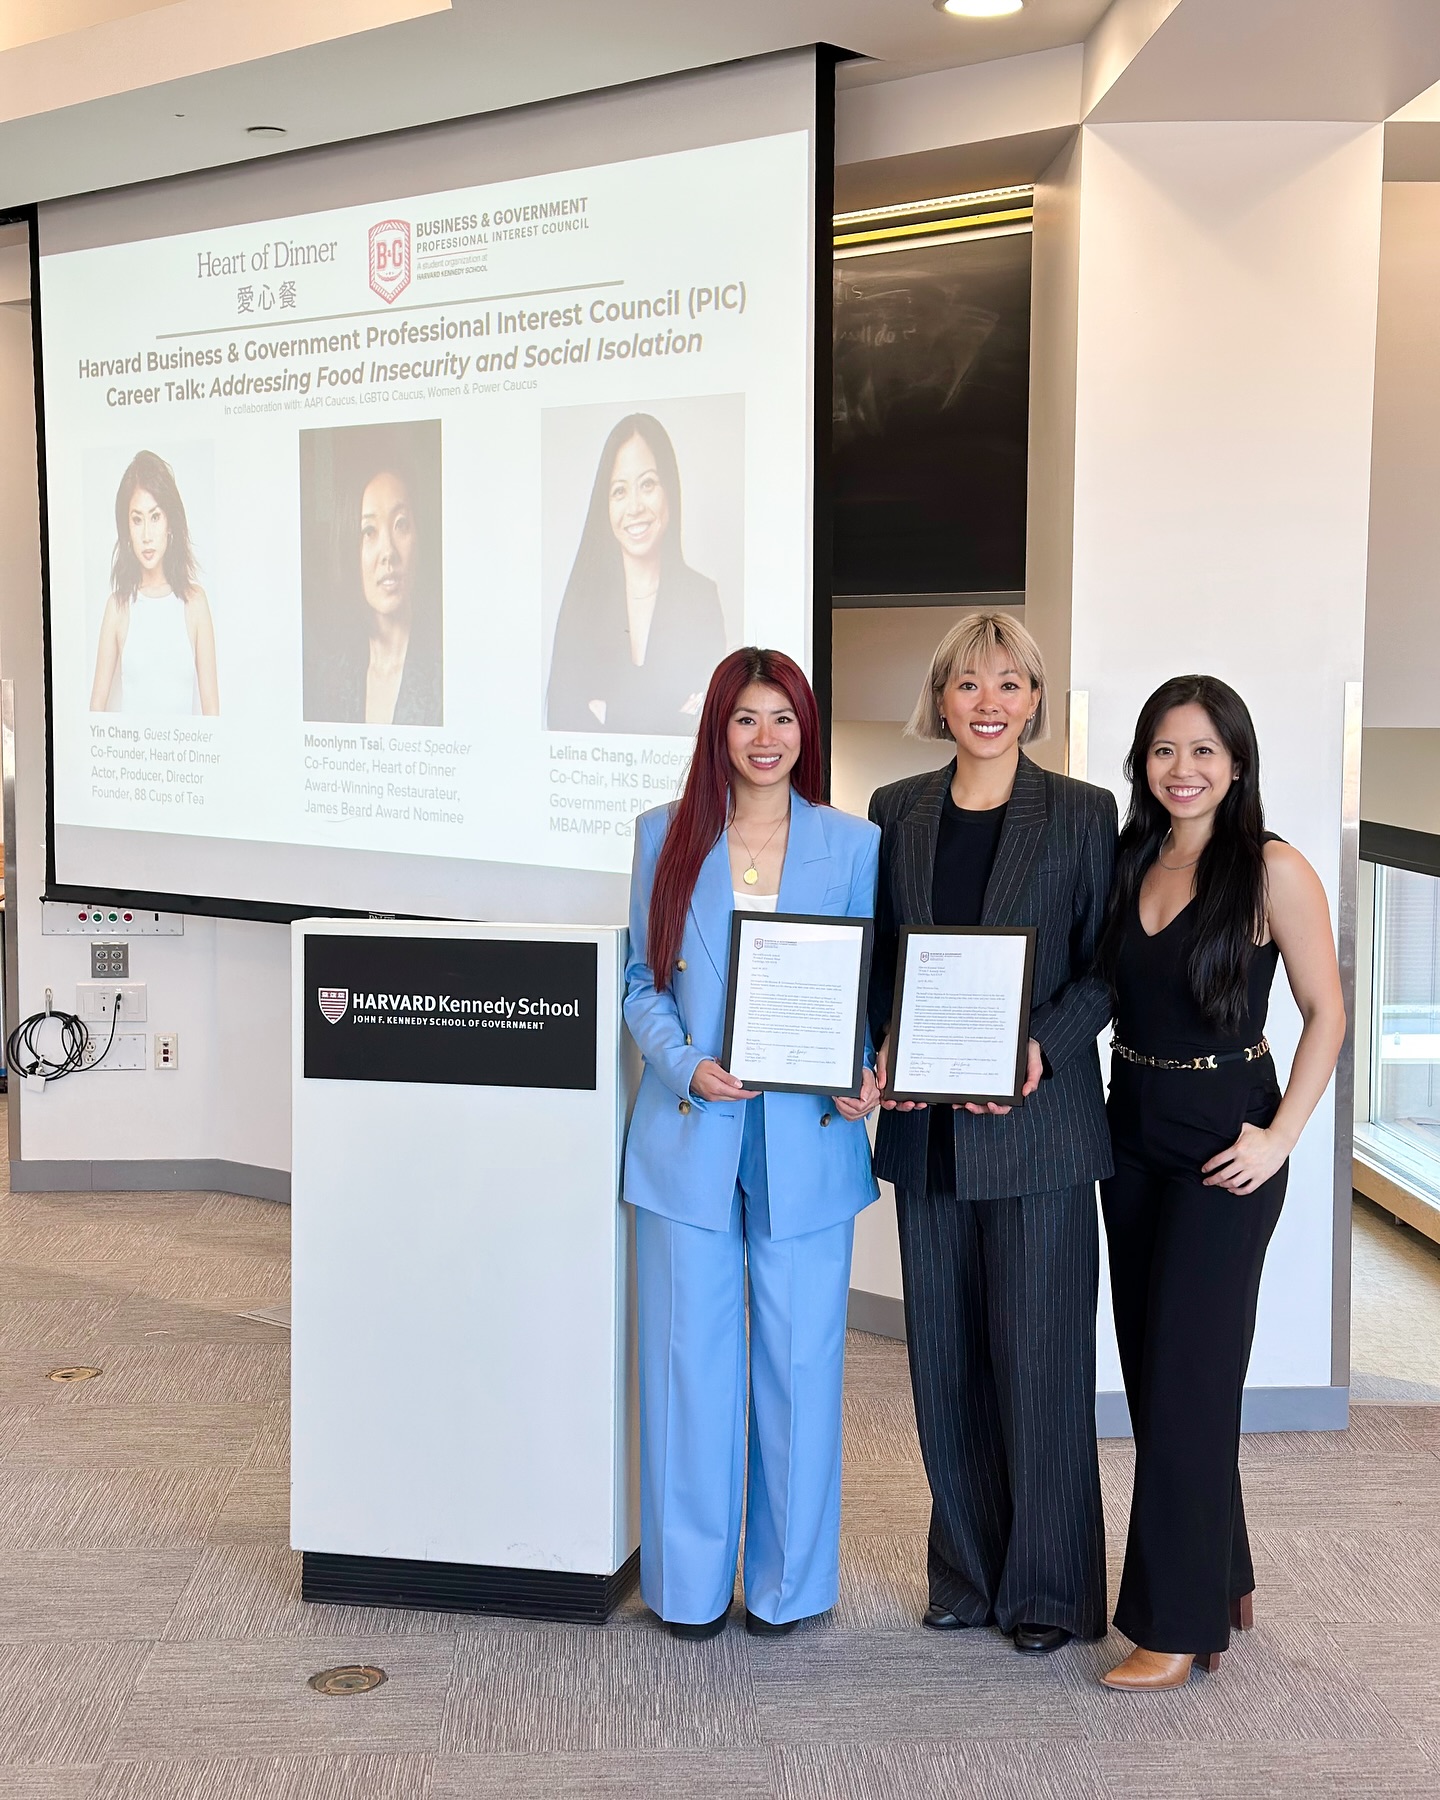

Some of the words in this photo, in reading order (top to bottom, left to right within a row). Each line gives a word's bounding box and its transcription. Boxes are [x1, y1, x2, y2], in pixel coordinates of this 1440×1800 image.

[416, 214, 477, 237] BUSINESS
[481, 212, 490, 228] &
[494, 197, 588, 226] GOVERNMENT
[416, 235, 489, 253] PROFESSIONAL
[492, 225, 538, 243] INTEREST
[542, 218, 590, 235] COUNCIL
[197, 251, 246, 278] Heart
[251, 243, 270, 271] of
[274, 240, 337, 269] Dinner
[422, 259, 444, 270] student
[445, 255, 481, 268] organization
[481, 254, 488, 262] at
[416, 270, 441, 281] HARVARD
[441, 267, 464, 277] KENNEDY
[465, 265, 488, 274] SCHOOL
[79, 352, 142, 379] Harvard
[147, 346, 223, 372] Business
[227, 342, 240, 363] &
[244, 329, 360, 361] Government
[366, 312, 490, 348] Professional
[497, 303, 583, 334] Interest
[590, 289, 680, 324] Council
[688, 281, 747, 319] (PIC)
[106, 387, 161, 407] Career
[165, 378, 205, 402] Talk:
[209, 368, 311, 398] Addressing
[316, 362, 365, 388] Food
[370, 351, 471, 380] Insecurity
[475, 345, 519, 373] and
[524, 338, 591, 369] Social
[597, 329, 703, 361] Isolation
[224, 405, 232, 415] In
[233, 401, 283, 415] collaboration
[304, 395, 323, 409] AAPI
[325, 395, 358, 407] Caucus,
[359, 390, 389, 404] LGBTQ
[391, 390, 425, 401] Caucus,
[428, 385, 461, 398] Women
[463, 384, 470, 395] &
[472, 382, 501, 394] Power
[503, 378, 538, 391] Caucus
[90, 725, 105, 738] Yin
[108, 726, 140, 743] Chang,
[144, 727, 171, 741] Guest
[173, 728, 213, 744] Speaker
[304, 734, 357, 752] Moonlynn
[389, 738, 422, 753] Guest
[424, 739, 472, 756] Speaker
[90, 745, 147, 761] Co-Founder,
[149, 748, 175, 762] Heart
[177, 749, 187, 762] of
[189, 750, 221, 764] Dinner
[591, 747, 637, 767] Chang,
[91, 766, 118, 780] Actor,
[120, 767, 164, 783] Producer,
[166, 769, 204, 784] Director
[304, 756, 369, 774] Co-Founder,
[372, 759, 402, 774] Heart
[405, 761, 417, 775] of
[419, 762, 456, 777] Dinner
[304, 778, 384, 799] Award-Winning
[387, 783, 461, 802] Restaurateur,
[550, 769, 608, 788] Co-Chair,
[611, 772, 638, 788] HKS
[642, 774, 678, 790] Busin
[92, 785, 132, 801] Founder,
[134, 788, 146, 801] 88
[149, 789, 172, 805] Cups
[174, 791, 184, 803] of
[187, 792, 204, 805] Tea
[550, 793, 626, 812] Government
[304, 800, 338, 815] James
[341, 802, 372, 817] Beard
[375, 804, 410, 820] Award
[413, 807, 464, 824] Nominee
[550, 817, 611, 835] MBA/MPP
[352, 993, 436, 1012] HARVARD
[439, 995, 516, 1019] Kennedy
[518, 998, 579, 1017] School
[353, 1015, 376, 1025] JOHN
[378, 1016, 385, 1024] F.
[387, 1016, 428, 1026] KENNEDY
[429, 1017, 466, 1027] SCHOOL
[468, 1019, 480, 1027] OF
[481, 1020, 544, 1030] GOVERNMENT
